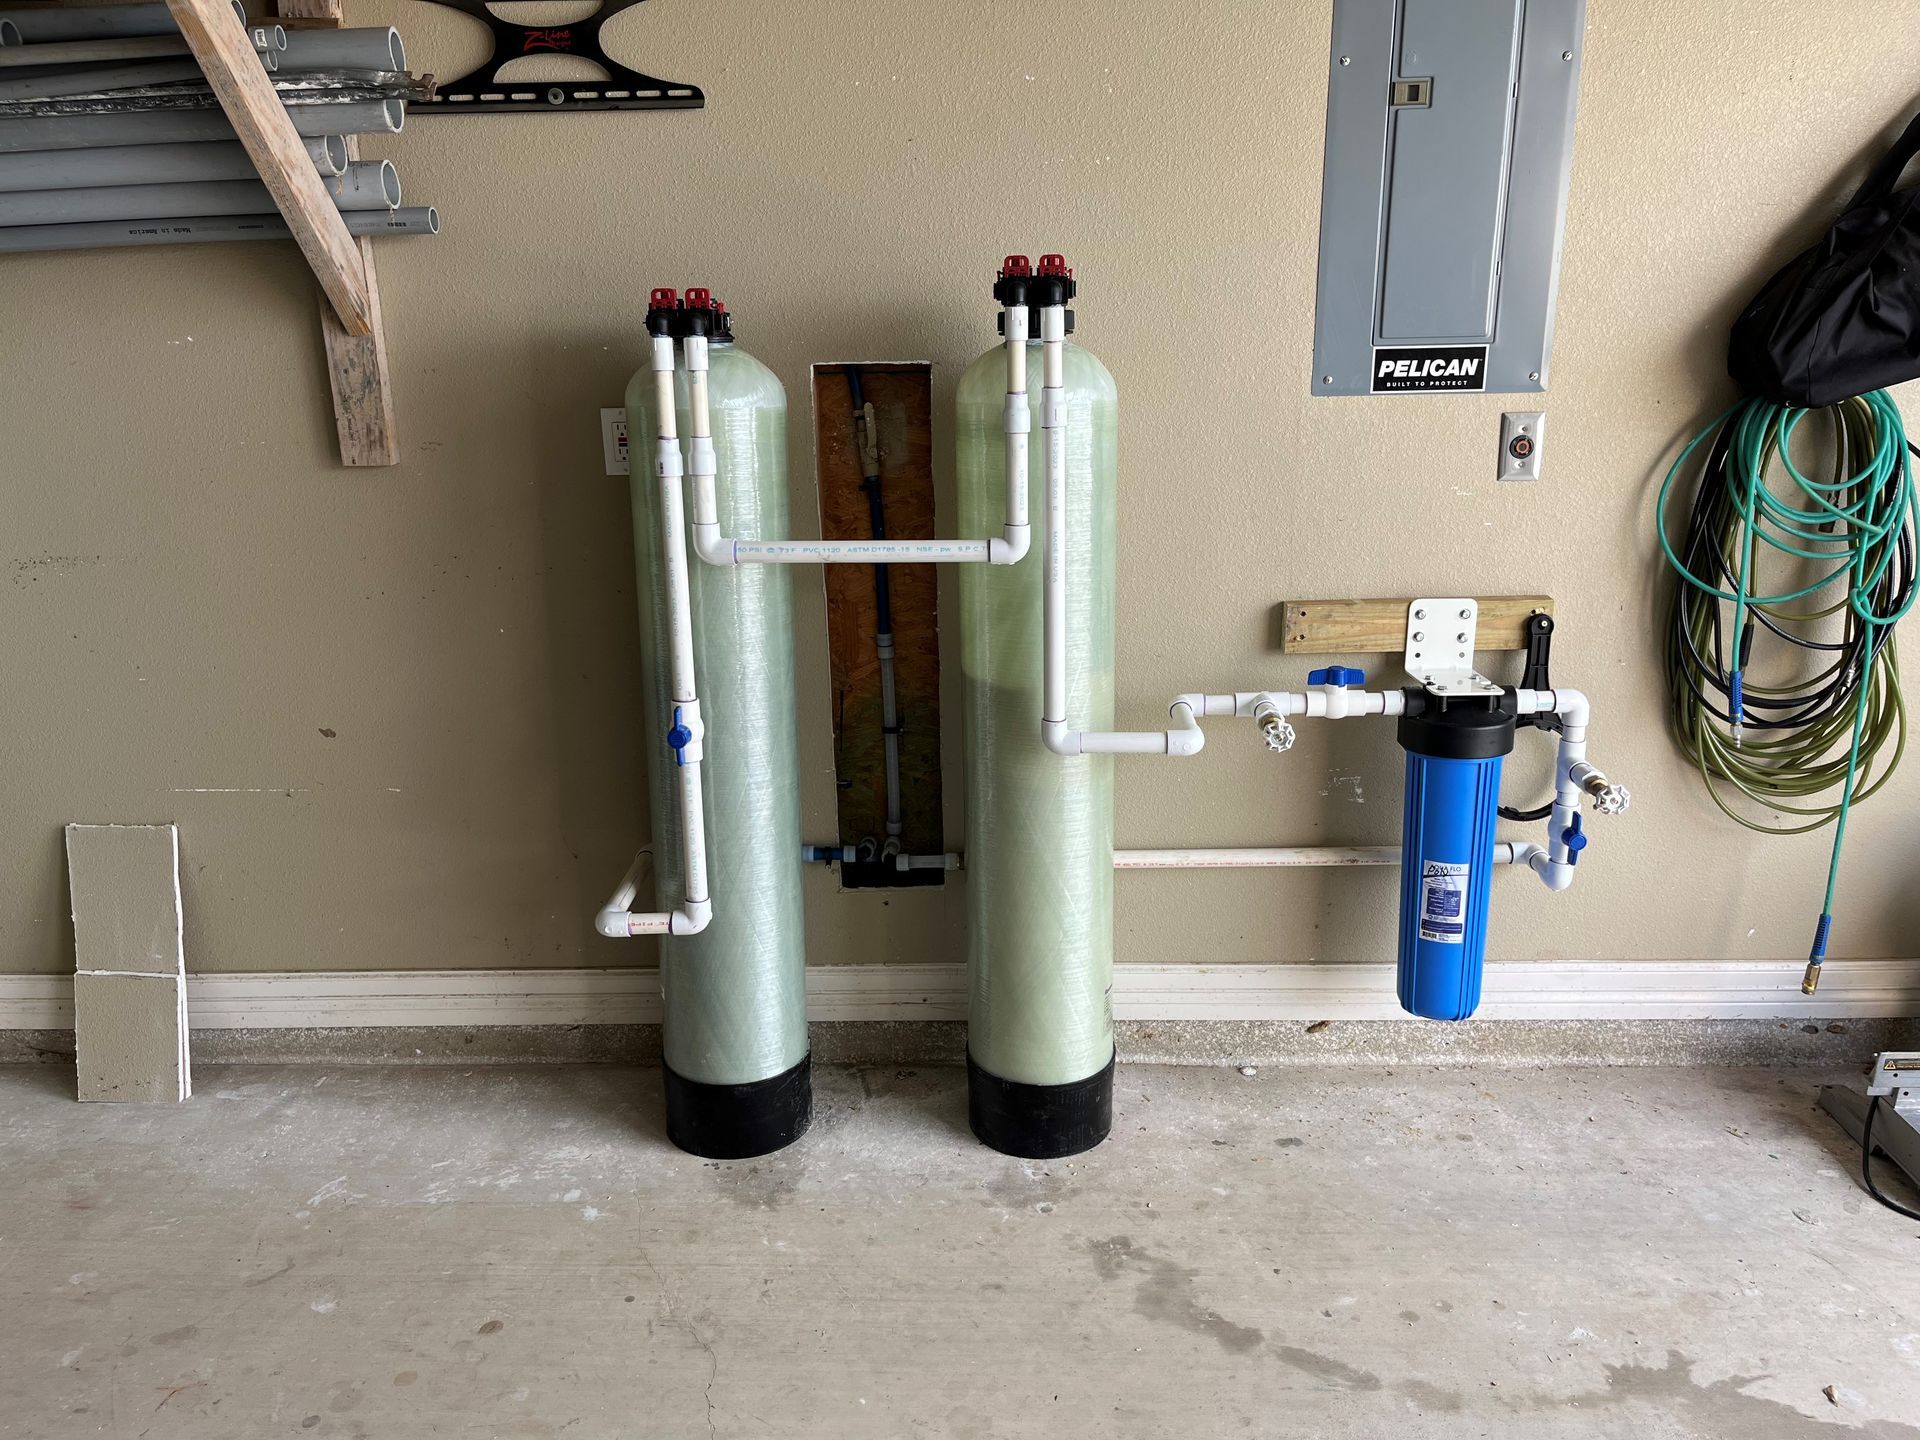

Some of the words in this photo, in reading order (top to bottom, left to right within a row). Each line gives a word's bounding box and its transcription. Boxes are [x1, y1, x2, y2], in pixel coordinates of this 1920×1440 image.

[128, 227, 158, 236] America
[173, 226, 192, 234] Made
[1378, 358, 1479, 378] PELICAN
[802, 546, 820, 554] PVC
[822, 546, 841, 554] 1120
[847, 545, 870, 554] ASTM
